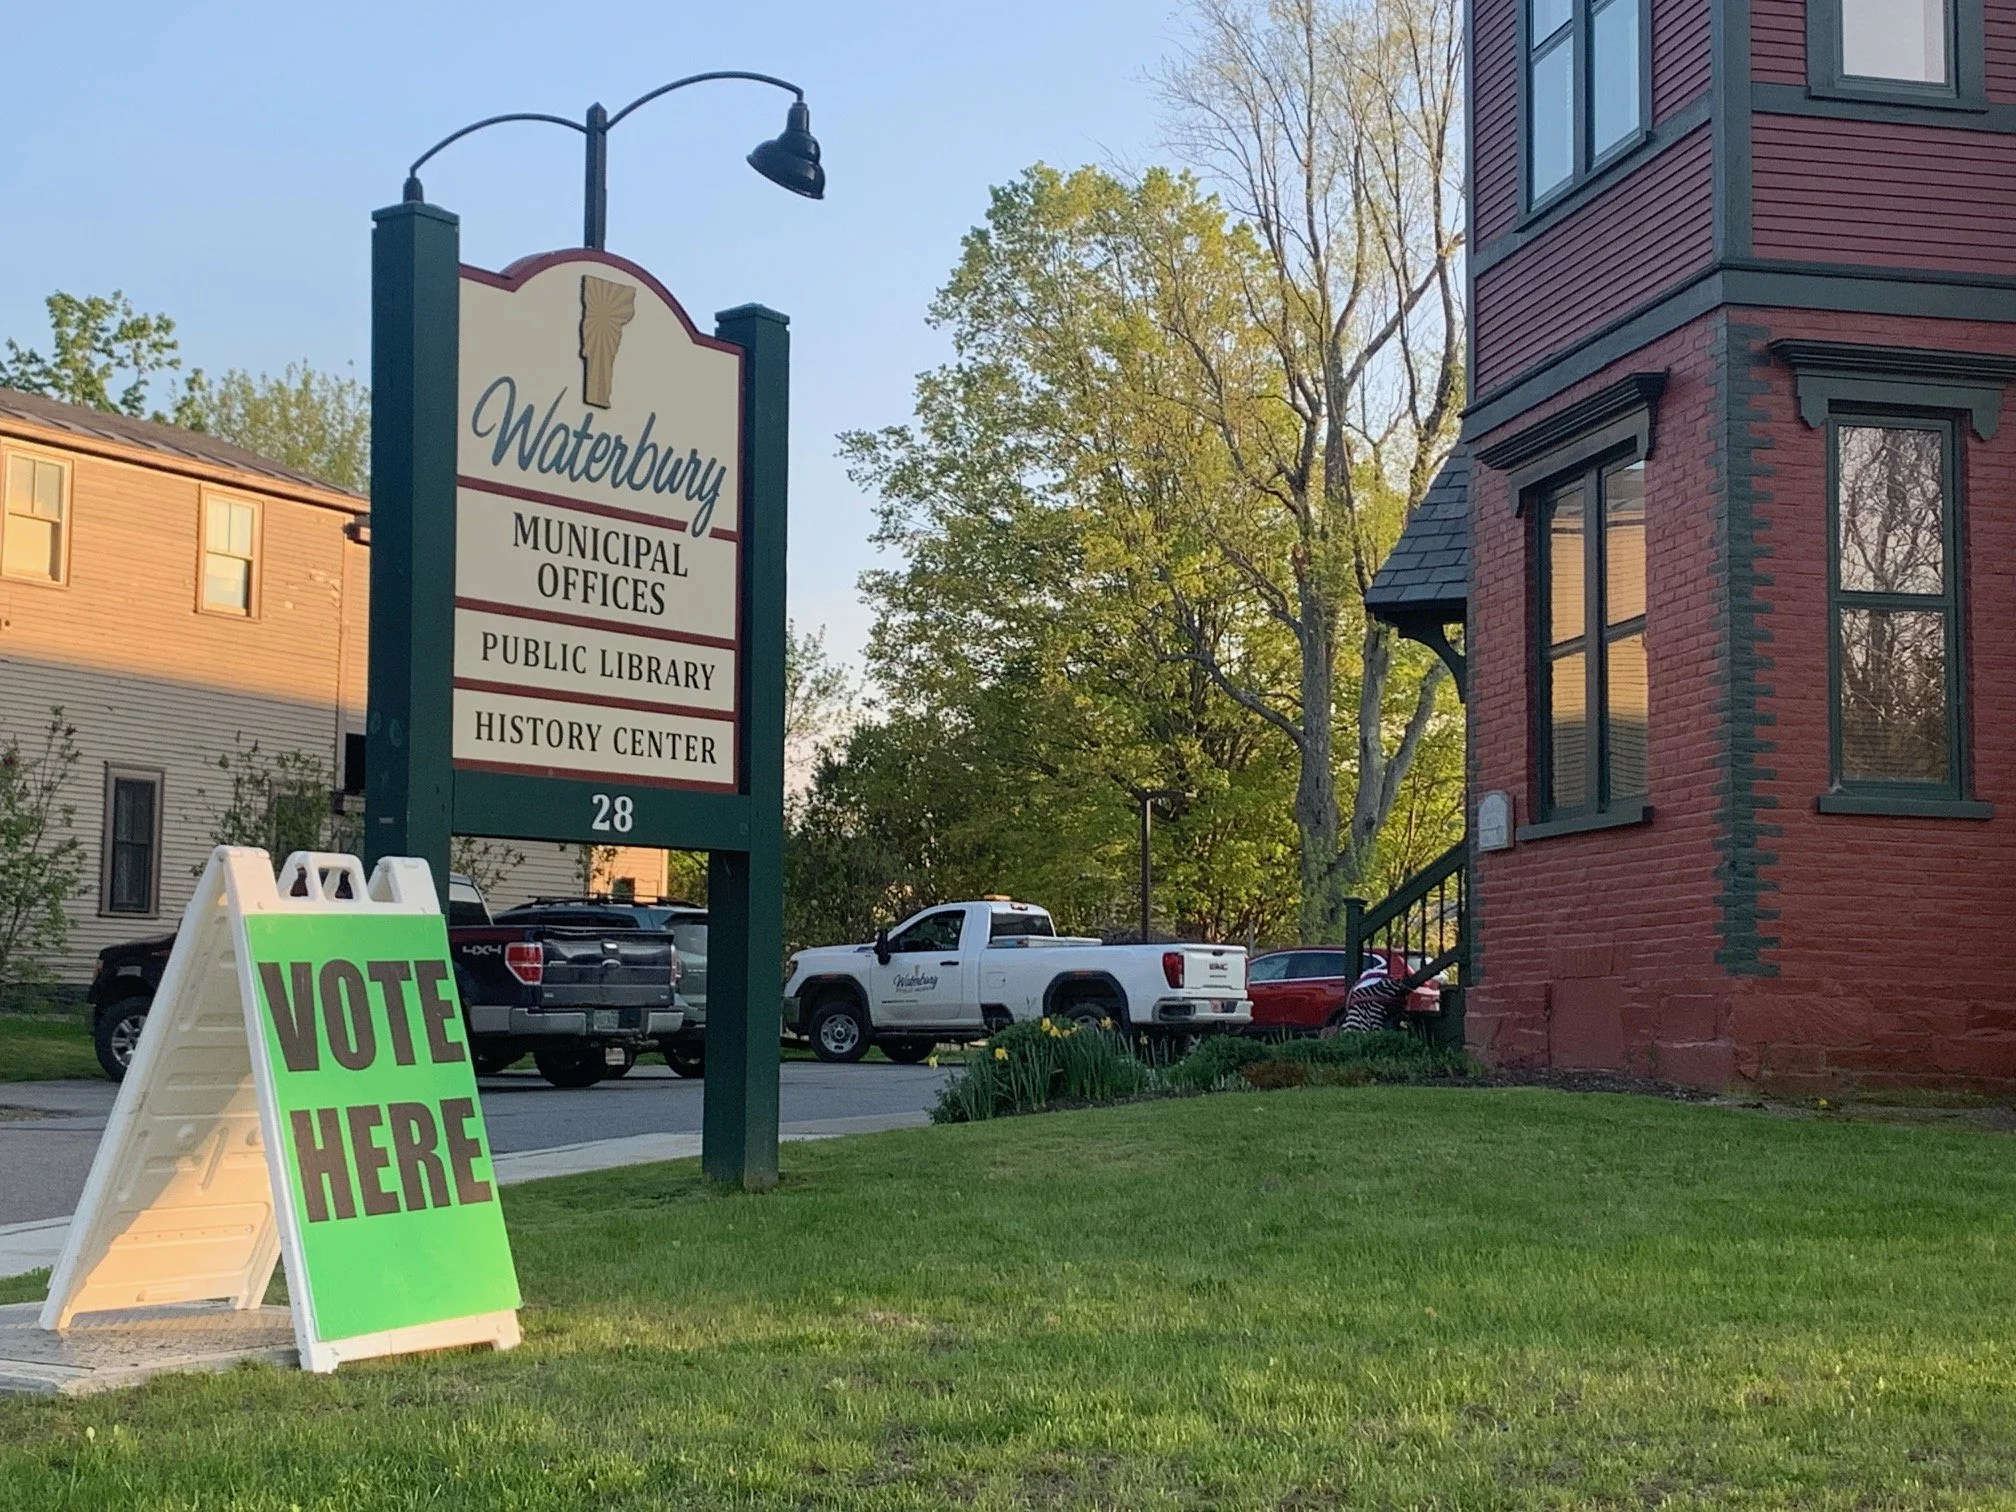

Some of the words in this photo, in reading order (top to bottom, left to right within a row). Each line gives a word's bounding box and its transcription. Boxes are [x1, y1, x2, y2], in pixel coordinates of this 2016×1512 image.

[471, 376, 727, 537] Waterbury
[512, 511, 689, 578] MUNICIPAL
[537, 562, 666, 616] OFFICES
[481, 631, 587, 675] PUBLIC
[600, 648, 716, 691] LIBRARY
[474, 710, 603, 752] HISTORY
[613, 726, 717, 765] CENTER
[591, 793, 634, 833] 28
[892, 972, 939, 991] Waterbury
[257, 958, 467, 1073] VOTE
[290, 1097, 494, 1223] HERE
